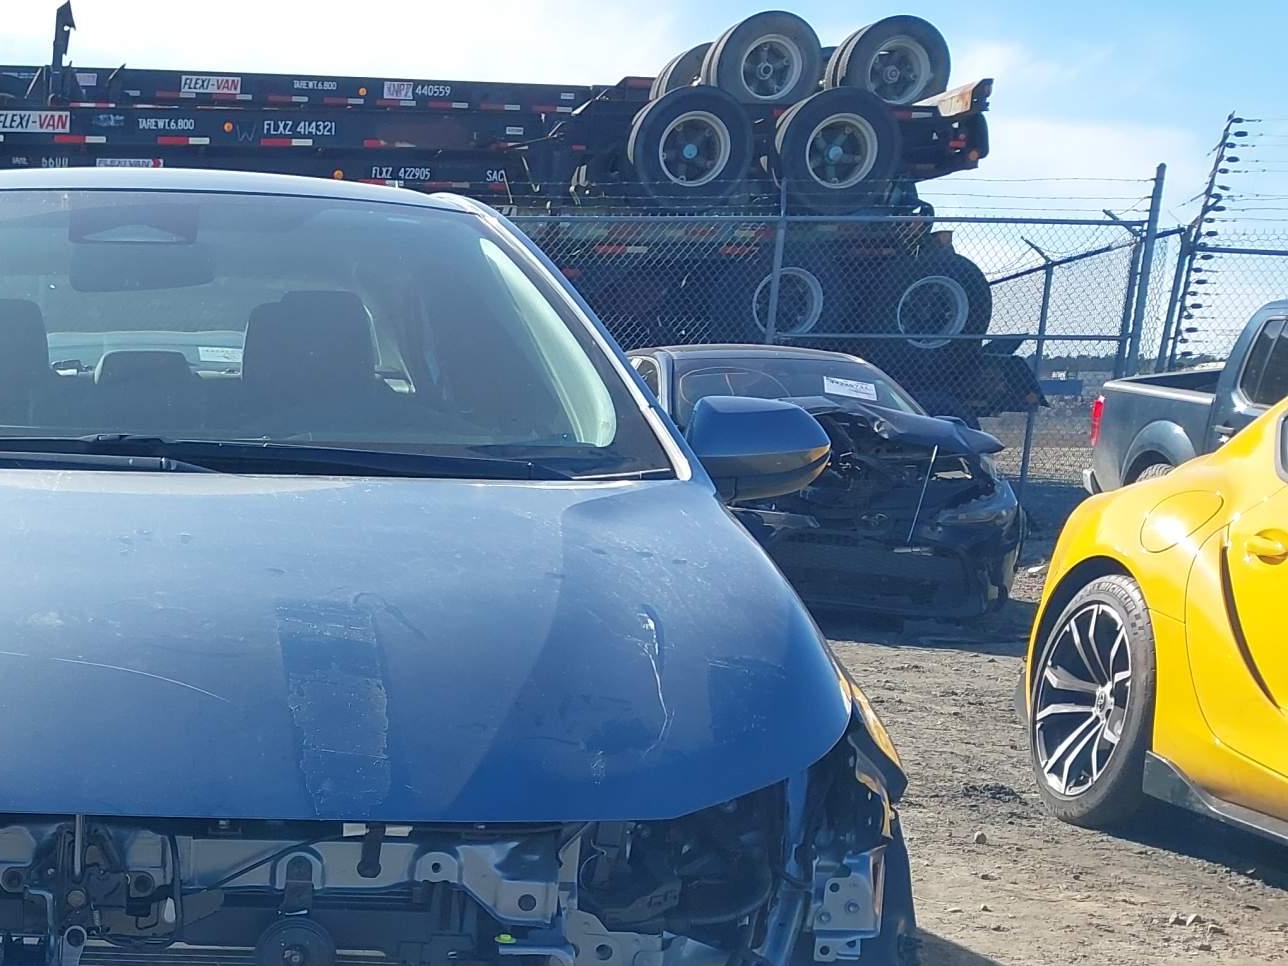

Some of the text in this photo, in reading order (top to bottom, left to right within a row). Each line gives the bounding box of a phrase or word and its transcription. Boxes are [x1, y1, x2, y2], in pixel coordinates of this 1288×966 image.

[182, 77, 240, 92] FLEXI-VAN
[415, 85, 451, 97] 440559
[263, 120, 336, 136] FLXZ 414321
[371, 167, 431, 180] FLXZ 422905
[1098, 581, 1137, 616] MICHELIN
